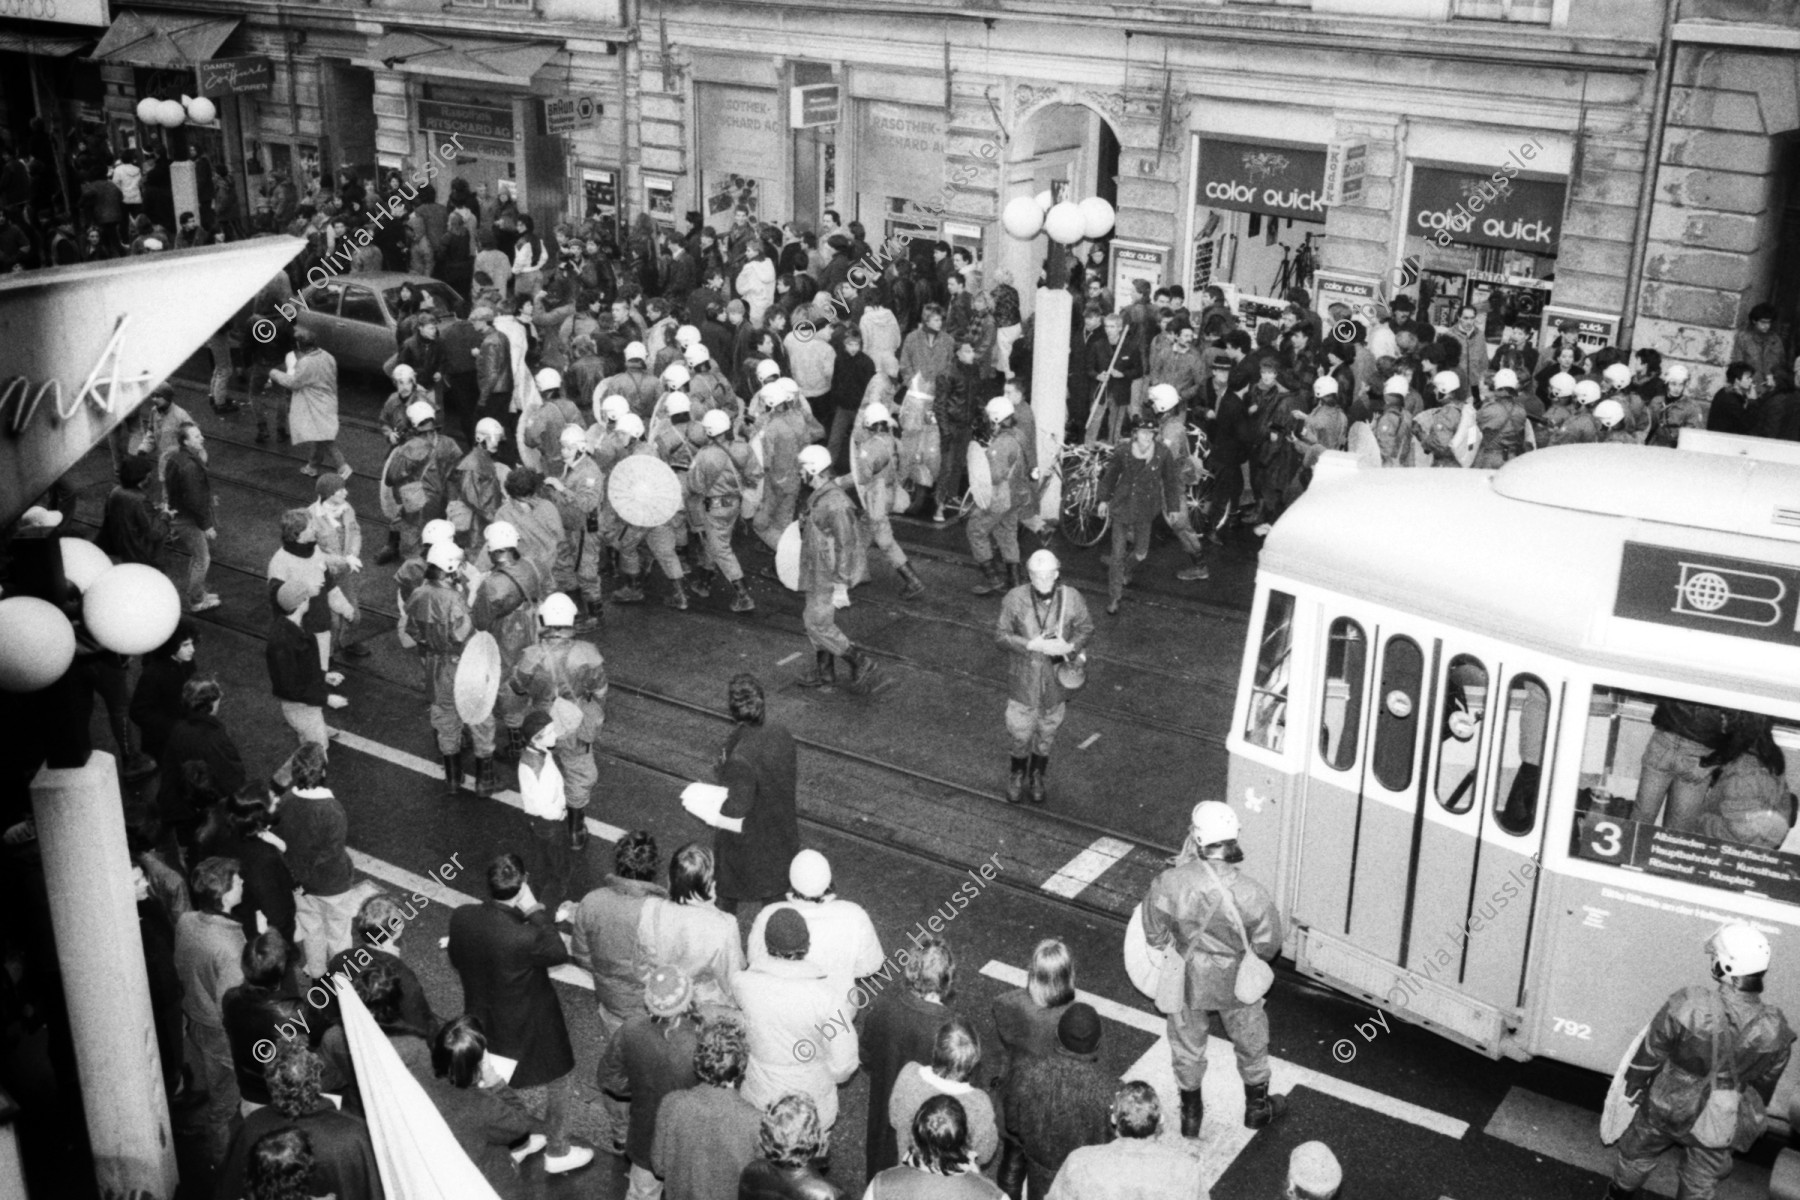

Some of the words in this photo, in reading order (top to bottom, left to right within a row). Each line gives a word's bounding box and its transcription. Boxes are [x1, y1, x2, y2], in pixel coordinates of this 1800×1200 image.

[1205, 180, 1257, 203] color
[1417, 209, 1476, 233] color
[1118, 250, 1136, 259] color
[1324, 282, 1343, 291] color
[1591, 821, 1622, 856] 3
[1651, 844, 1721, 866] Hauptbahnhof
[1736, 862, 1791, 881] Kunsthaus
[1552, 1016, 1592, 1040] 792
